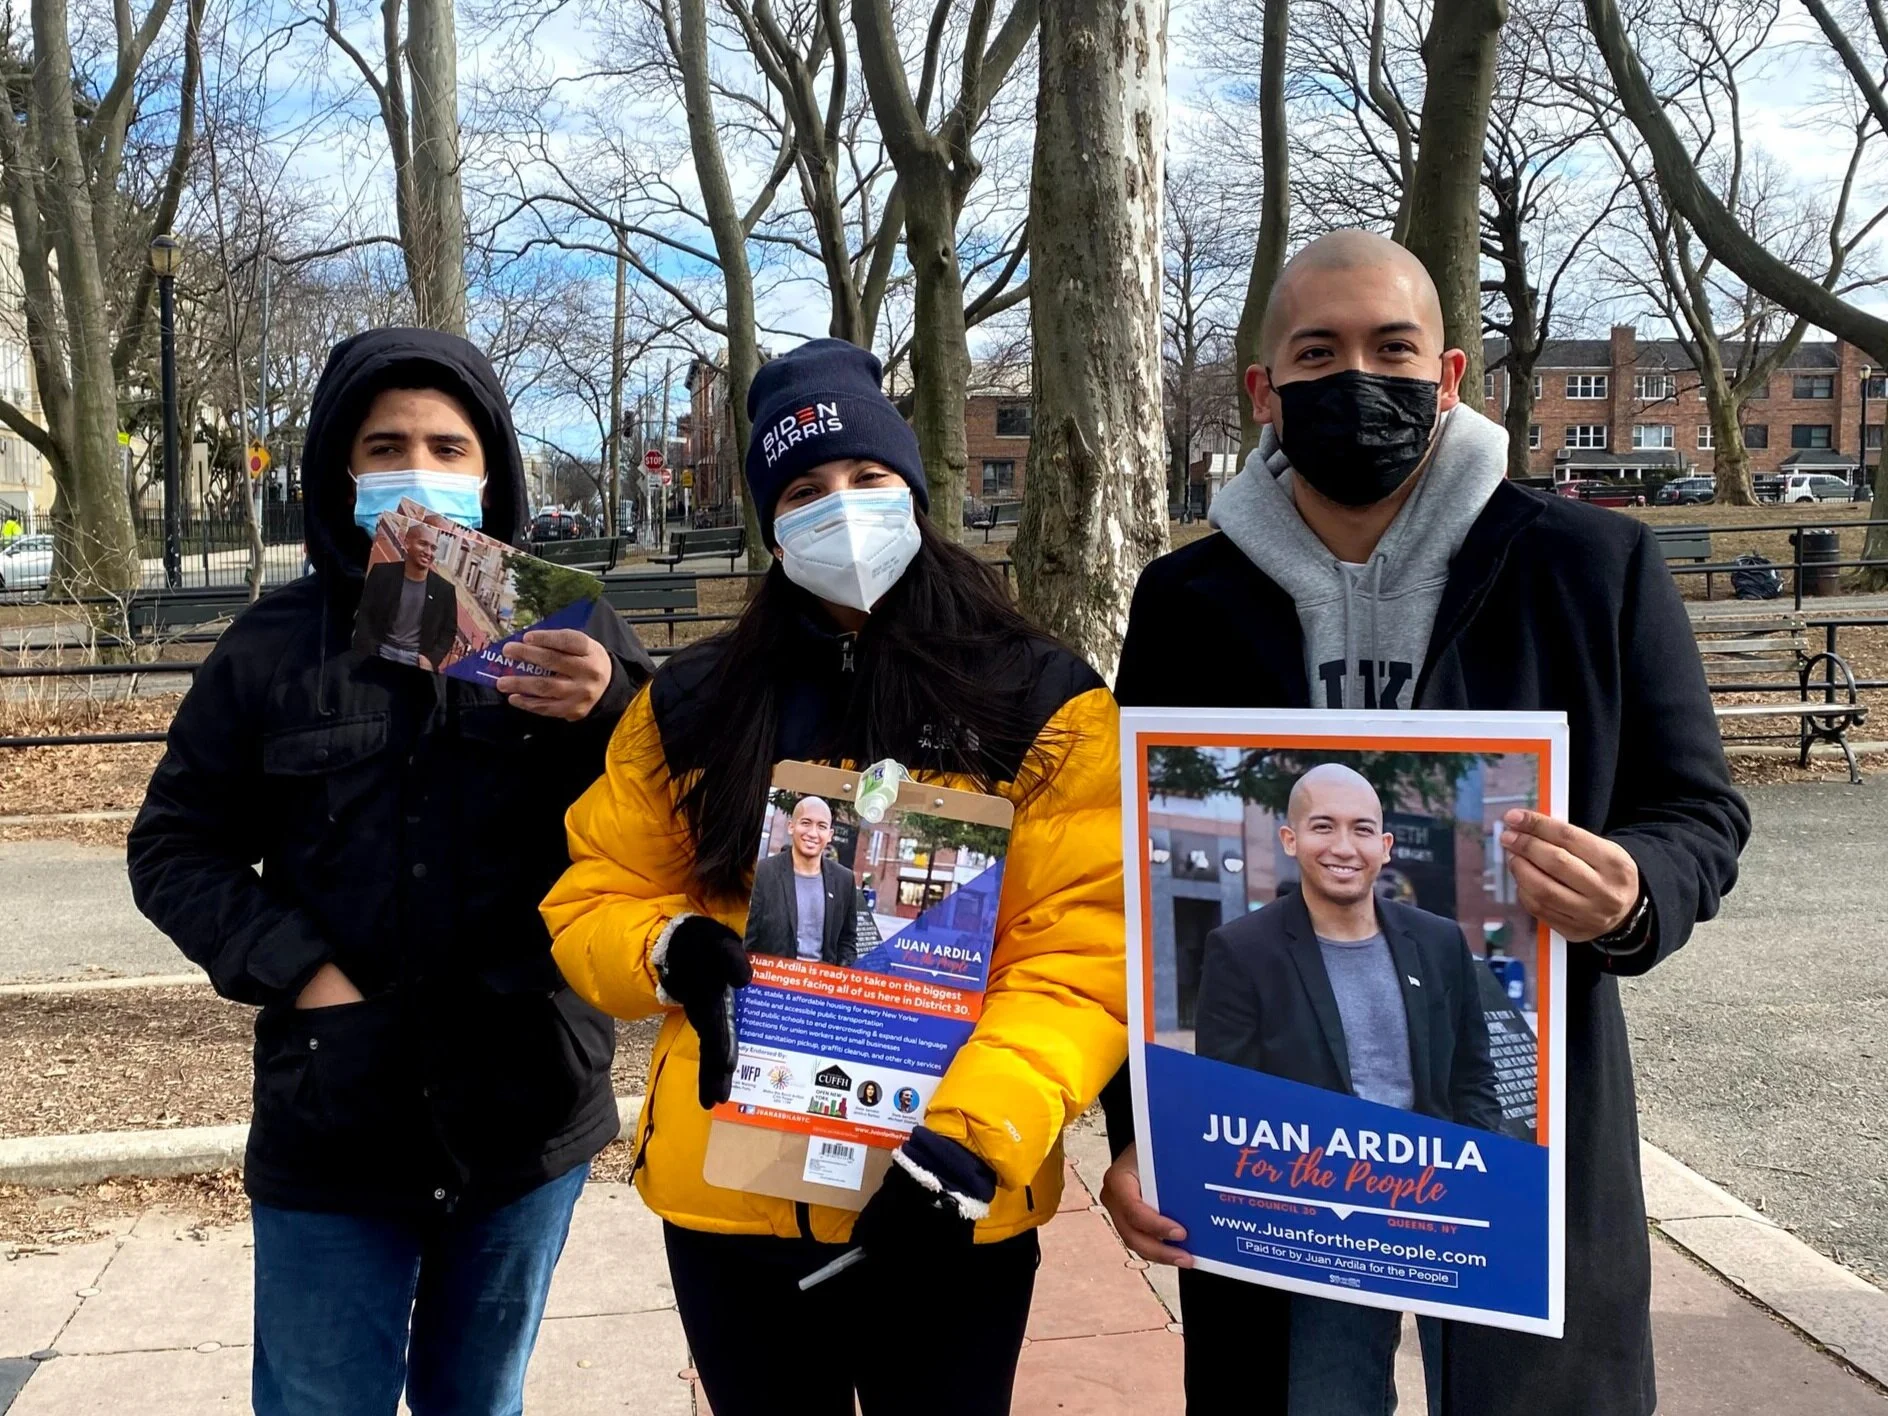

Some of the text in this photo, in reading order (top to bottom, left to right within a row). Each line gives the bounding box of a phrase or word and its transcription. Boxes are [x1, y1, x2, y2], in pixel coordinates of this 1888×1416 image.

[762, 401, 838, 453] BIDEN
[765, 417, 843, 469] HARRIS
[644, 456, 663, 465] STOP
[481, 650, 514, 668] JUAN
[894, 937, 982, 964] JUAN ARDILA
[749, 955, 962, 1001] Juan Ardila is ready to take on the biggest
[752, 969, 971, 1016] hallenges facing all of us here in District 30.
[745, 997, 771, 1008] Reliable
[784, 1005, 817, 1016] accessible
[817, 1010, 837, 1020] public
[837, 1014, 884, 1027] transportation
[791, 996, 826, 1007] affordable
[826, 1001, 852, 1012] housing
[852, 1005, 862, 1013] for
[863, 1008, 881, 1017] every
[882, 1011, 897, 1019] New
[898, 1013, 919, 1023] Yorker
[741, 1017, 901, 1051] Protections for union workers and small businesses
[743, 1007, 760, 1016] Fund
[761, 1010, 780, 1020] public
[781, 1015, 805, 1024] schools
[814, 1021, 827, 1029] end
[827, 1023, 872, 1038] overcrowding
[879, 1032, 903, 1042] expand
[903, 1036, 918, 1044] dual
[918, 1038, 948, 1051] language
[740, 1028, 764, 1039] Expand
[764, 1033, 797, 1045] sanitation
[797, 1039, 820, 1050] pickup,
[820, 1044, 844, 1053] graffiti
[871, 1052, 885, 1060] and
[884, 1054, 903, 1063] other
[903, 1057, 916, 1067] city
[916, 1061, 942, 1070] services
[740, 1064, 761, 1082] WFP
[818, 1074, 849, 1088] CUFFH
[1202, 1113, 1488, 1173] JUAN ARDILA
[1234, 1146, 1448, 1209] For the People
[1219, 1192, 1317, 1216] CITY COUNCIL 30
[1210, 1214, 1487, 1268] www.JuanforthePeople.com
[1441, 1224, 1458, 1235] NY
[1245, 1241, 1449, 1285] Paid for by Juan Ardila for the People
